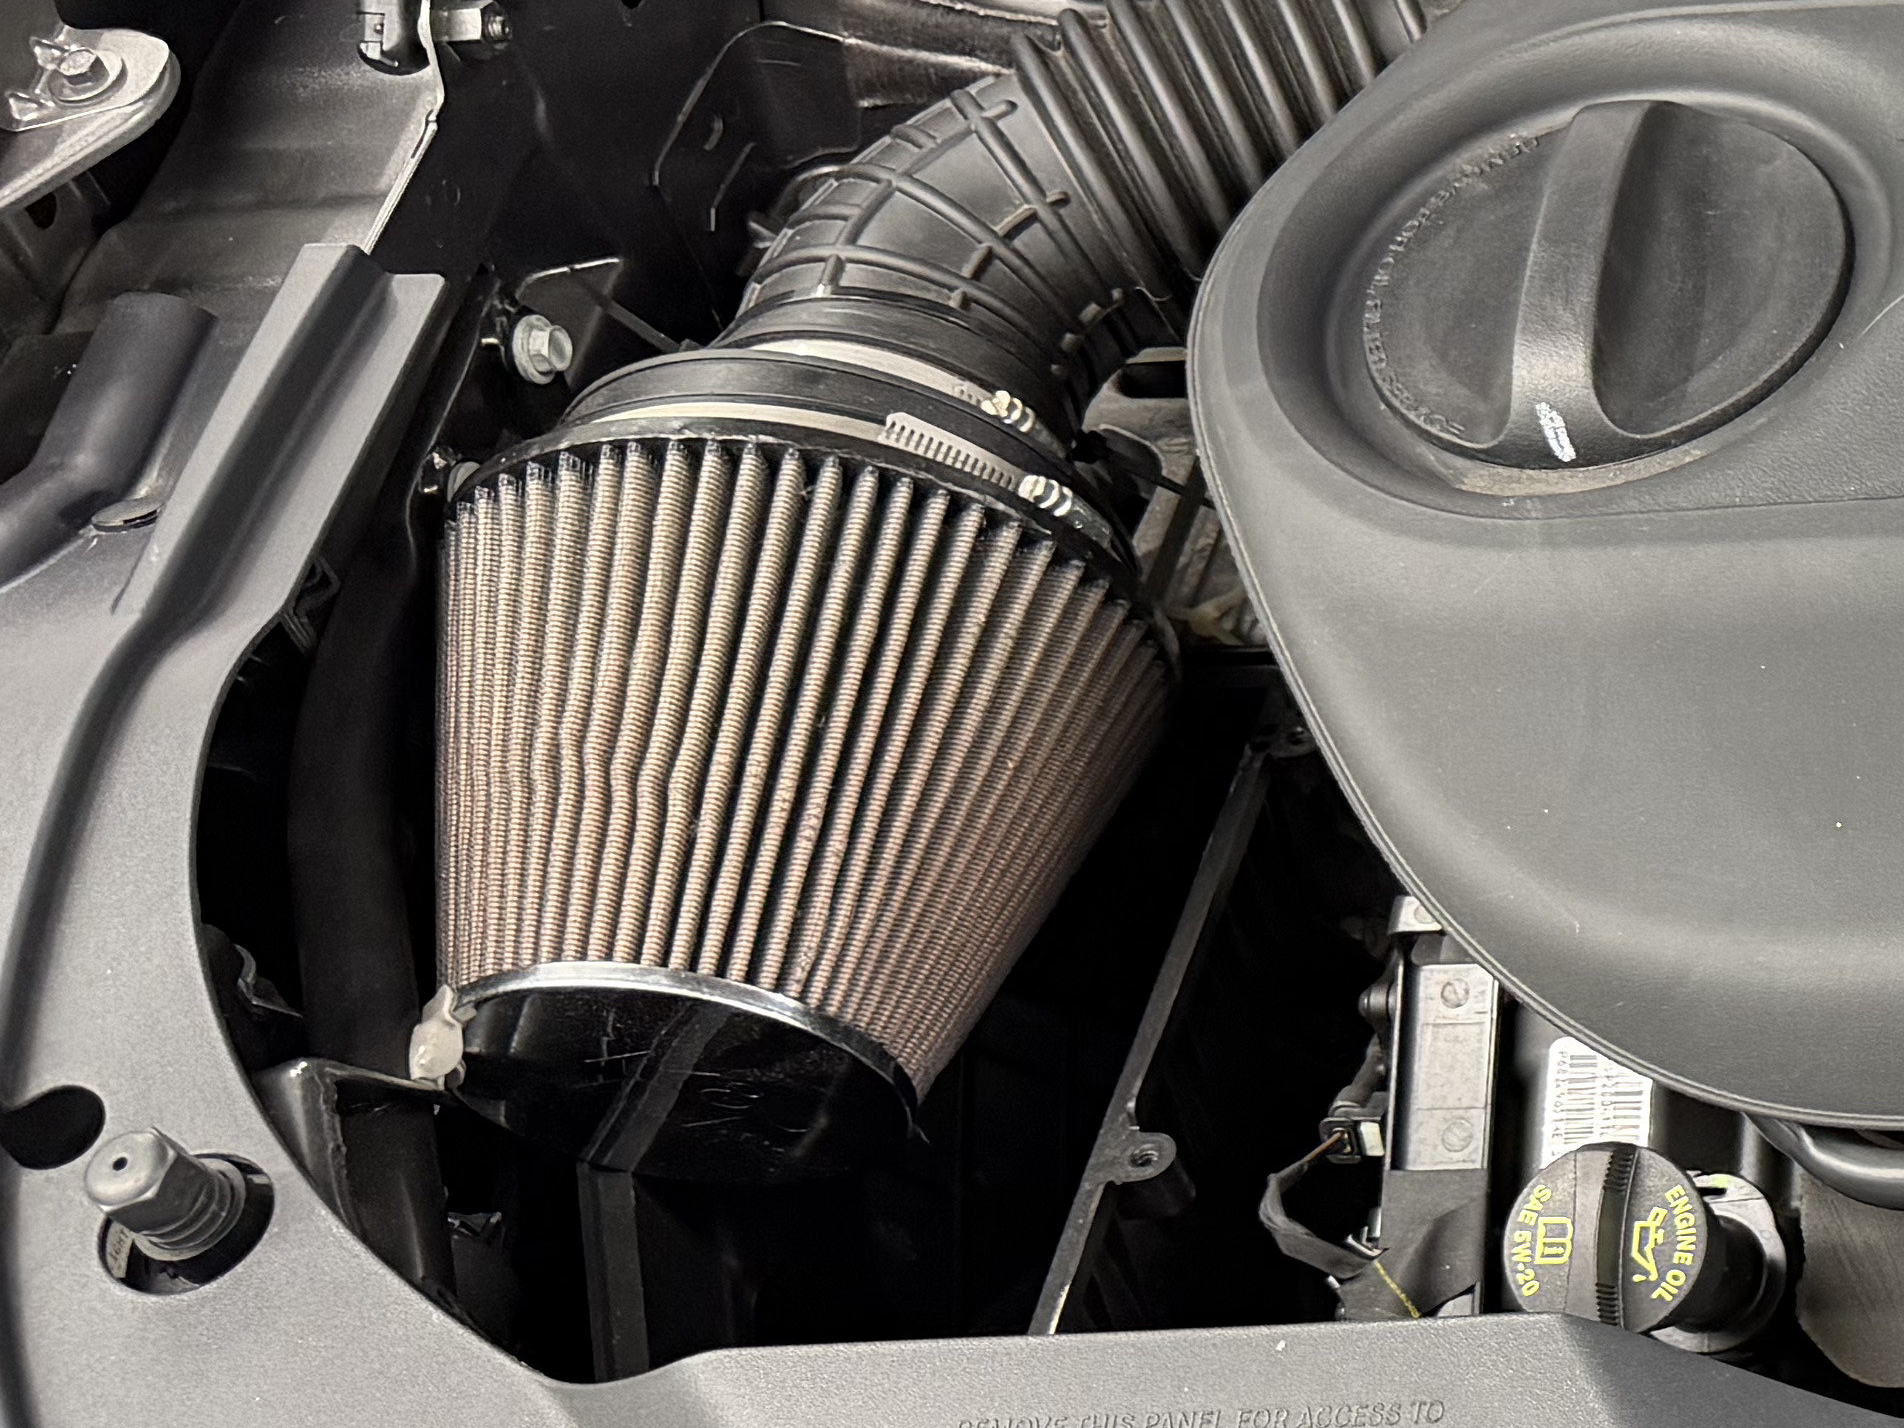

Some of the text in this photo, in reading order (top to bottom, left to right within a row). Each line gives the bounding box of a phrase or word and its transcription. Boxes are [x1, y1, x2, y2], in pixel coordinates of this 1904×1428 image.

[1511, 1184, 1552, 1297] SAE 5W-20
[1651, 1184, 1697, 1302] ENGINE OIL
[1410, 1399, 1446, 1424] TO
